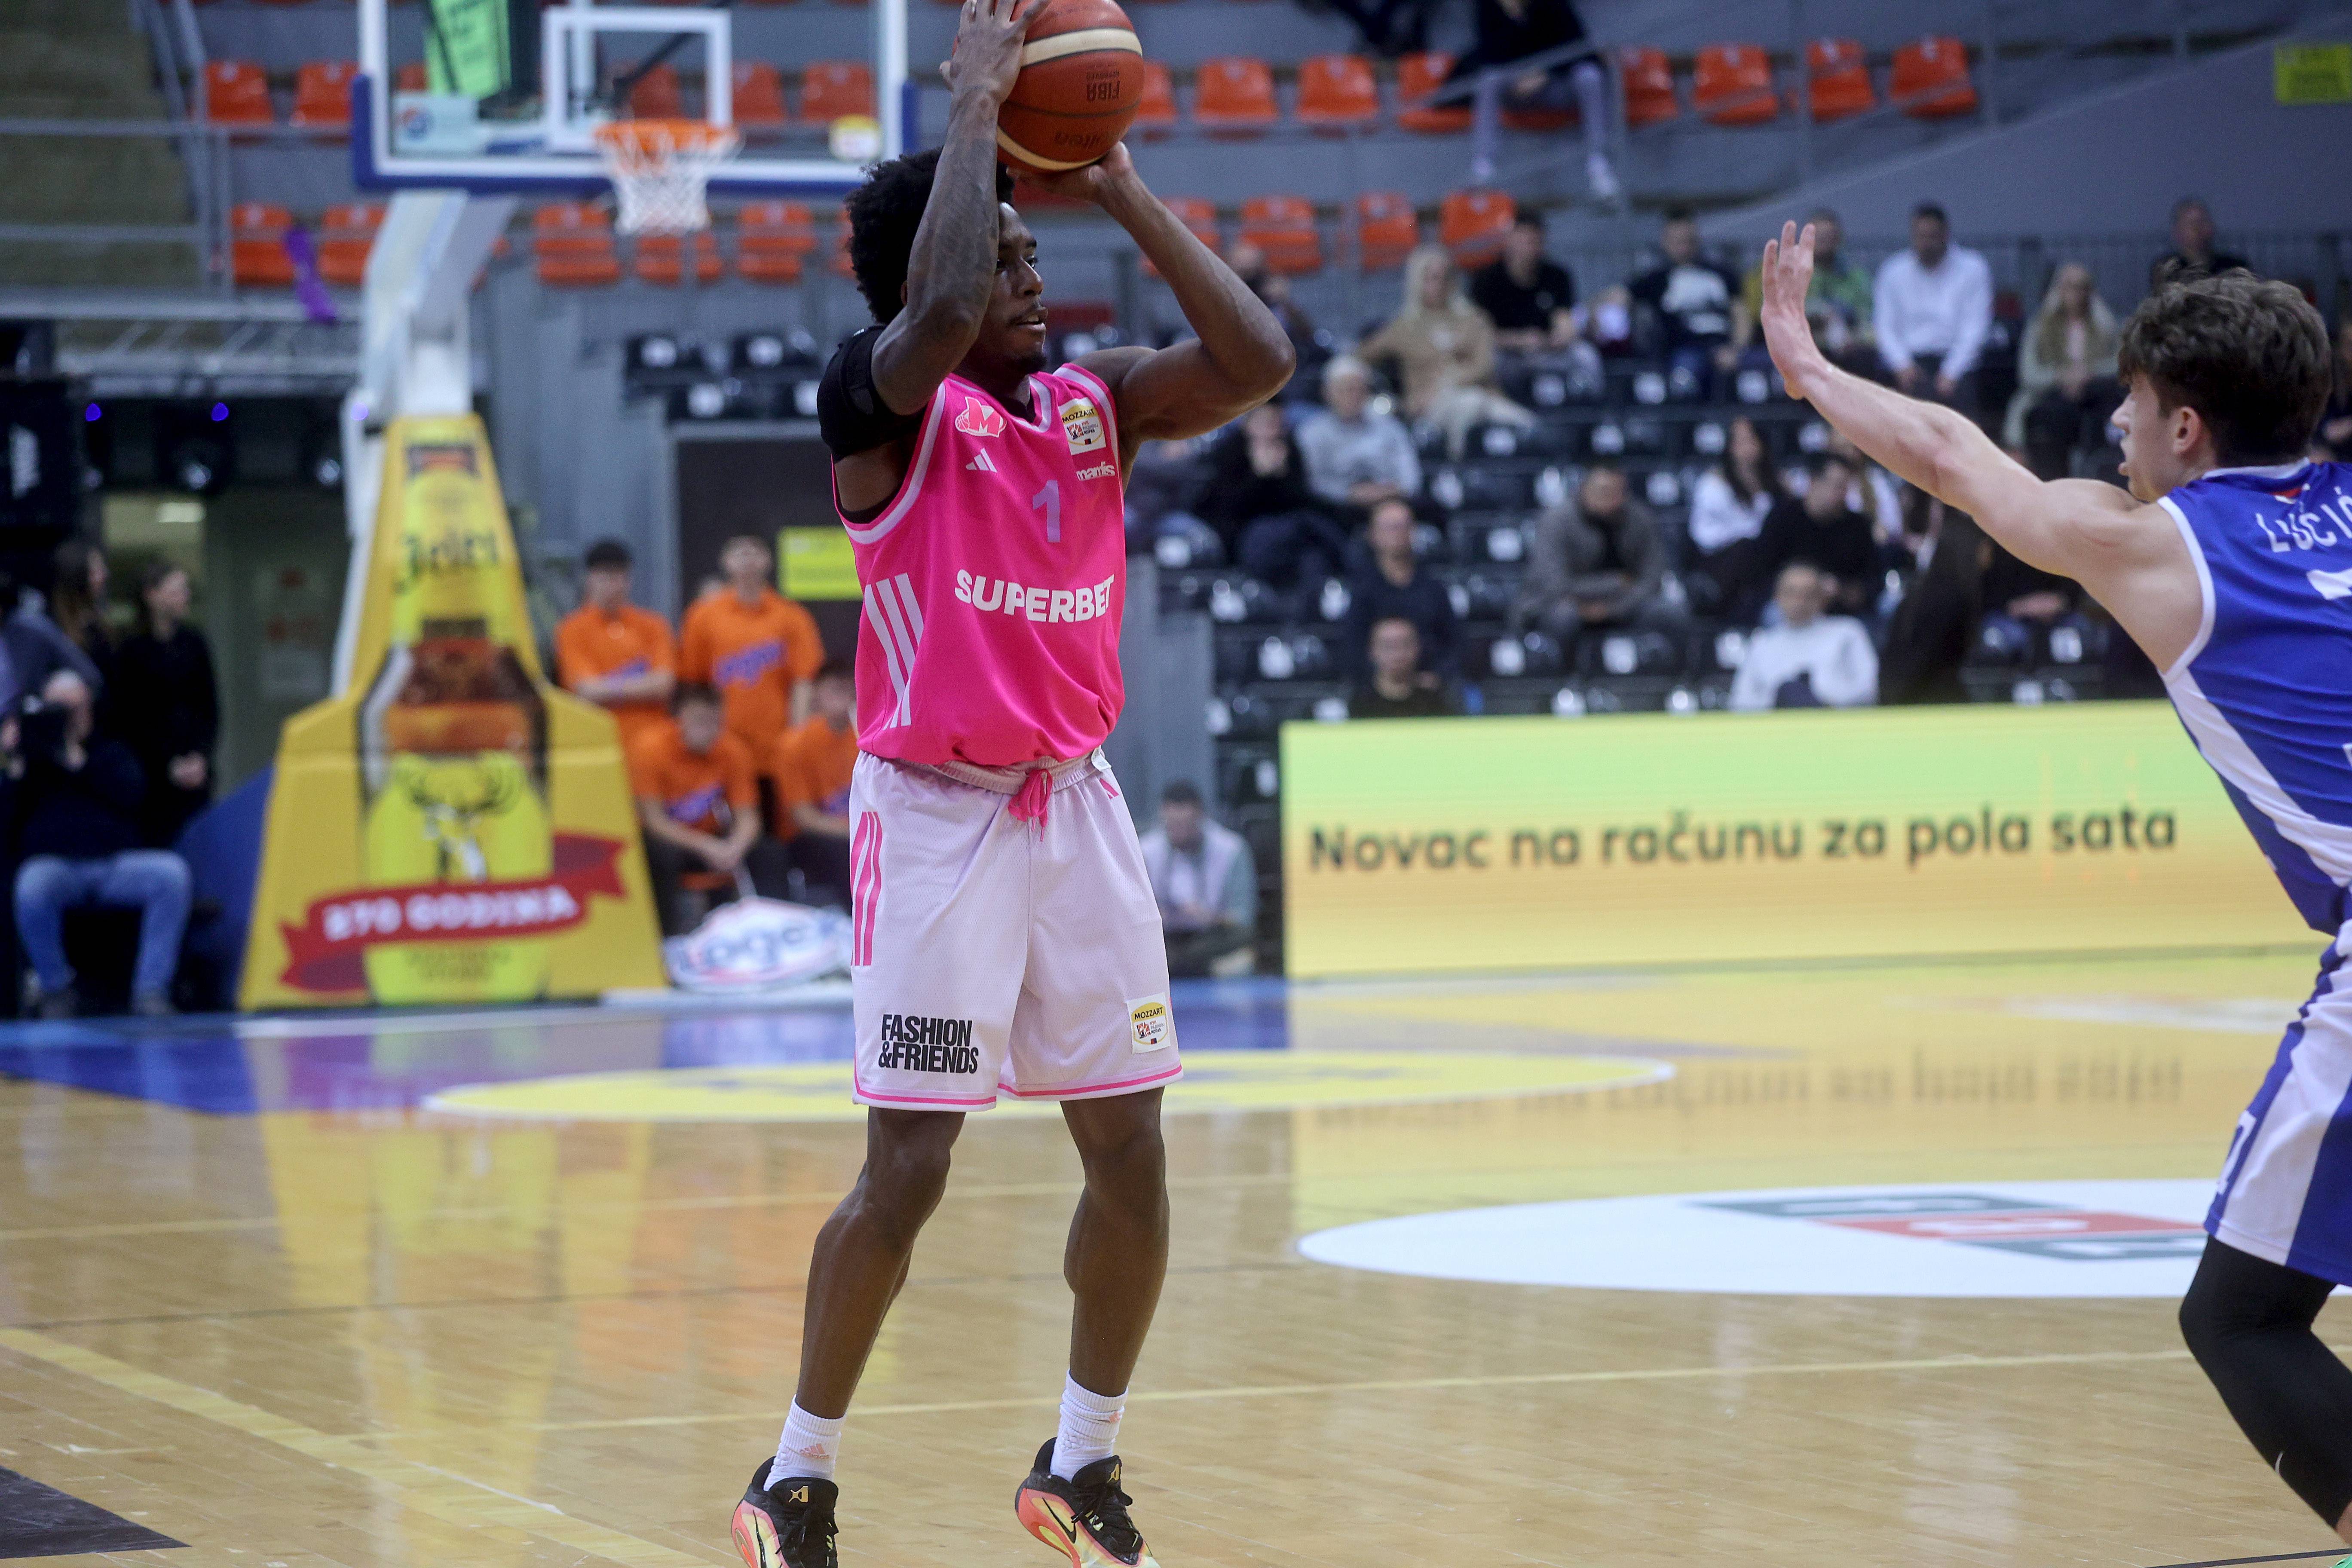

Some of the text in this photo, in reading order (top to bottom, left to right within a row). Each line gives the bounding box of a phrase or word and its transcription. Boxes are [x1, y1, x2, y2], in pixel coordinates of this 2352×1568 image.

[1086, 80, 1120, 103] FIBA
[1062, 409, 1094, 423] MOZZART
[1032, 480, 1061, 542] 1
[955, 569, 1115, 623] SUPERBET
[1309, 804, 2176, 873] Novac na računu za pola sata
[405, 884, 579, 931] GODINA
[1134, 1007, 1163, 1020] MOZZART
[882, 1014, 972, 1047] FASHION
[878, 1041, 979, 1074] &FRIENDS
